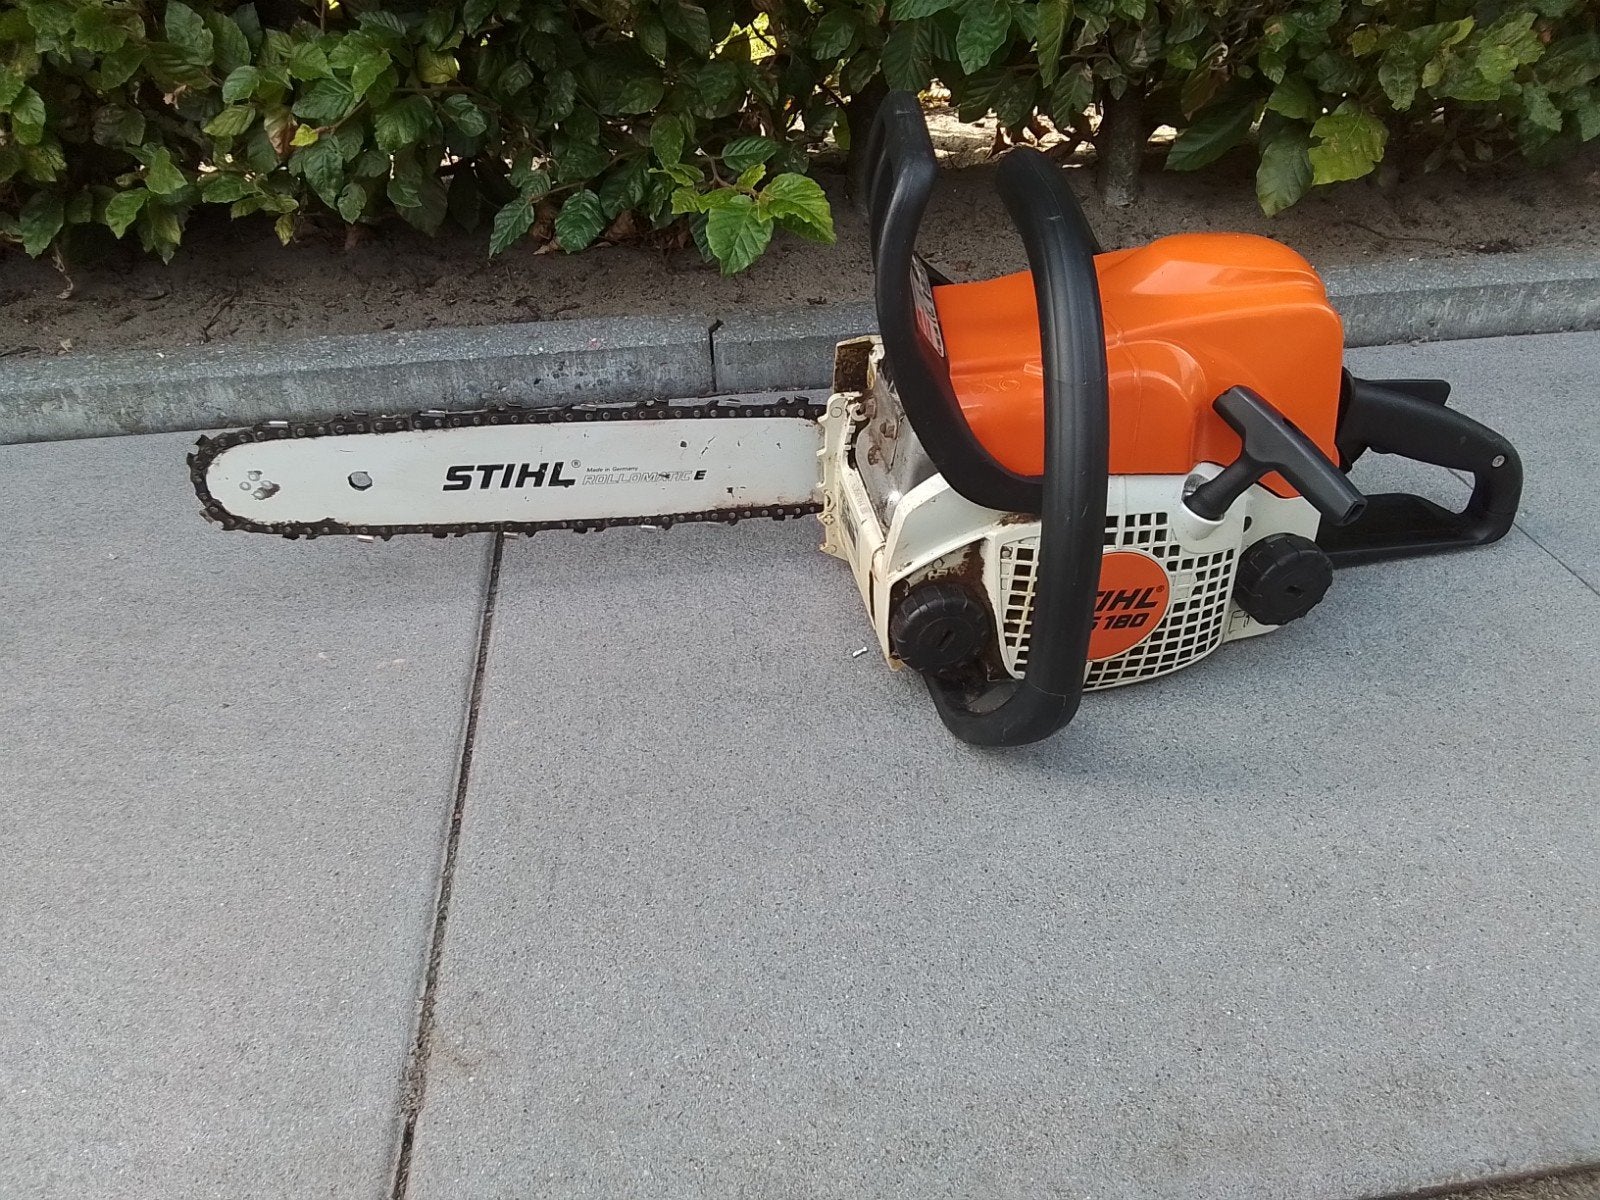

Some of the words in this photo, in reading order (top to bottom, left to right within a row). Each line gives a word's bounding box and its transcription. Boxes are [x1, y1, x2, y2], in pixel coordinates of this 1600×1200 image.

[442, 462, 575, 491] STIHL
[693, 470, 707, 480] E
[1103, 613, 1150, 630] 180
